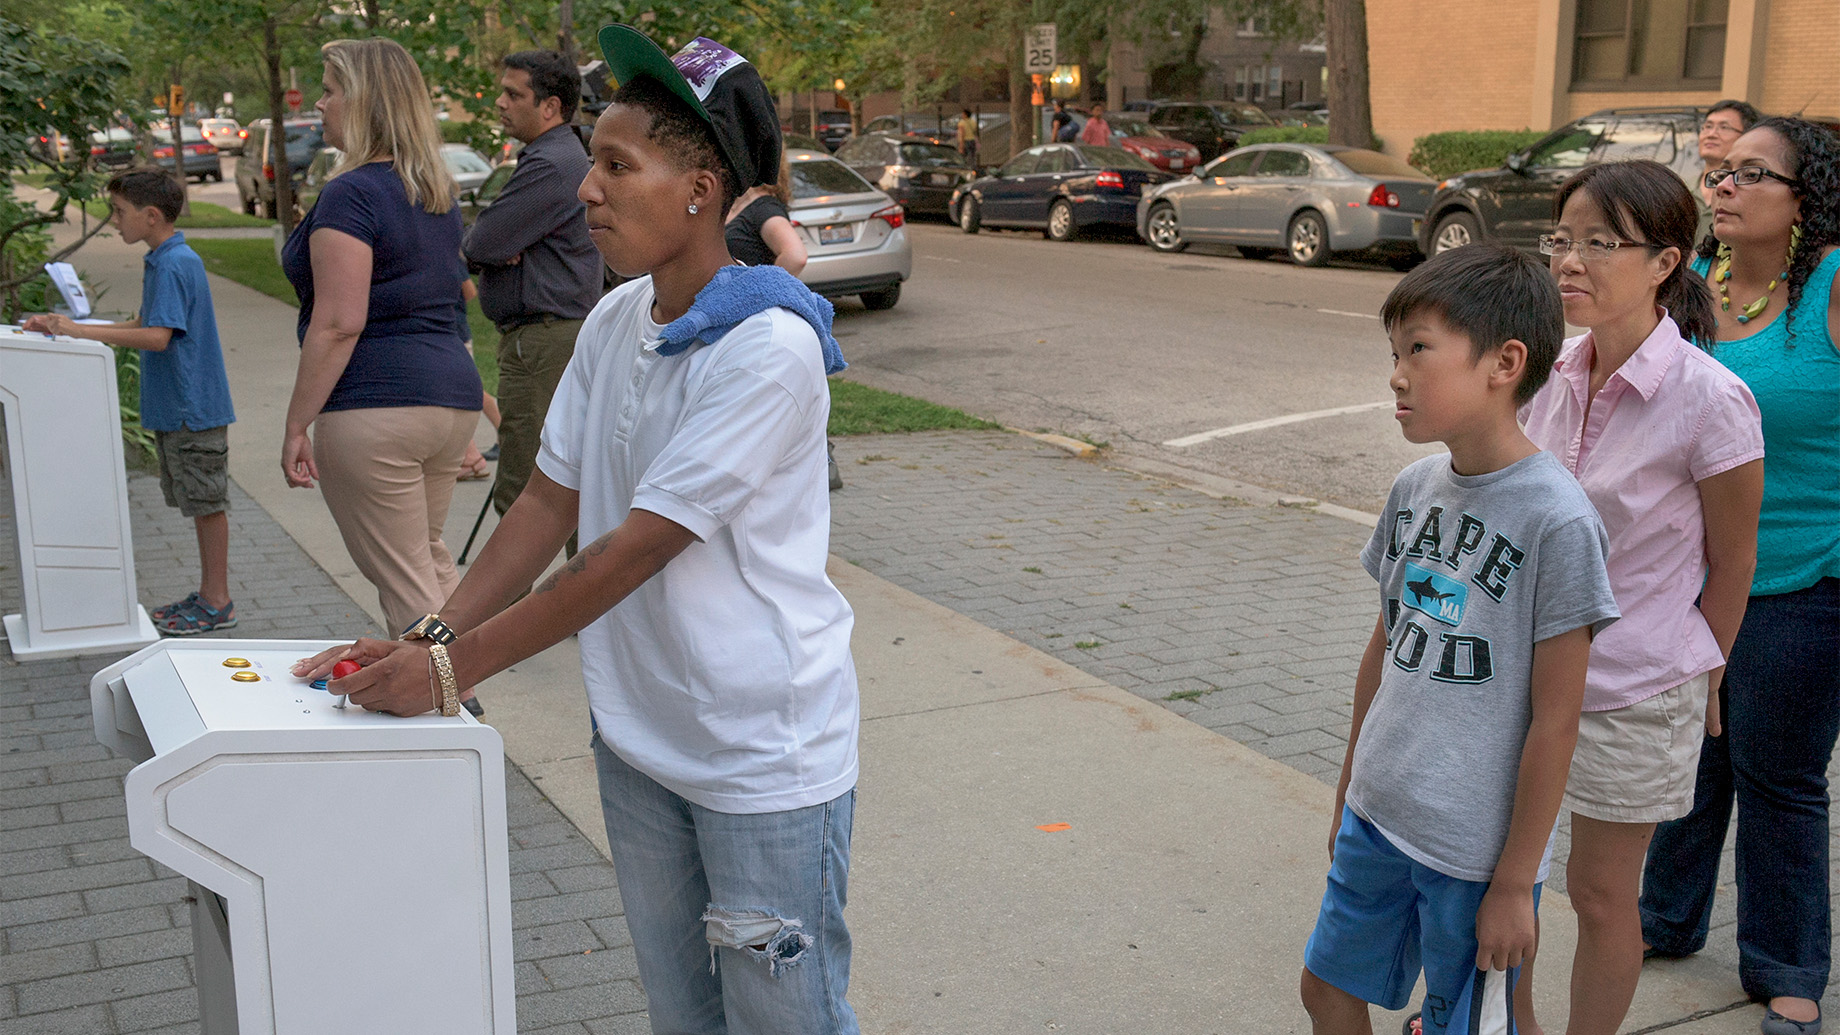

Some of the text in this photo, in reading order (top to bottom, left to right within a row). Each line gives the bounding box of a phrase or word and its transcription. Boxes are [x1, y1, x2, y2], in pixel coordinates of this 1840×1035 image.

[1029, 49, 1053, 67] 25
[1386, 504, 1526, 604] CAPE
[1439, 600, 1460, 621] MA
